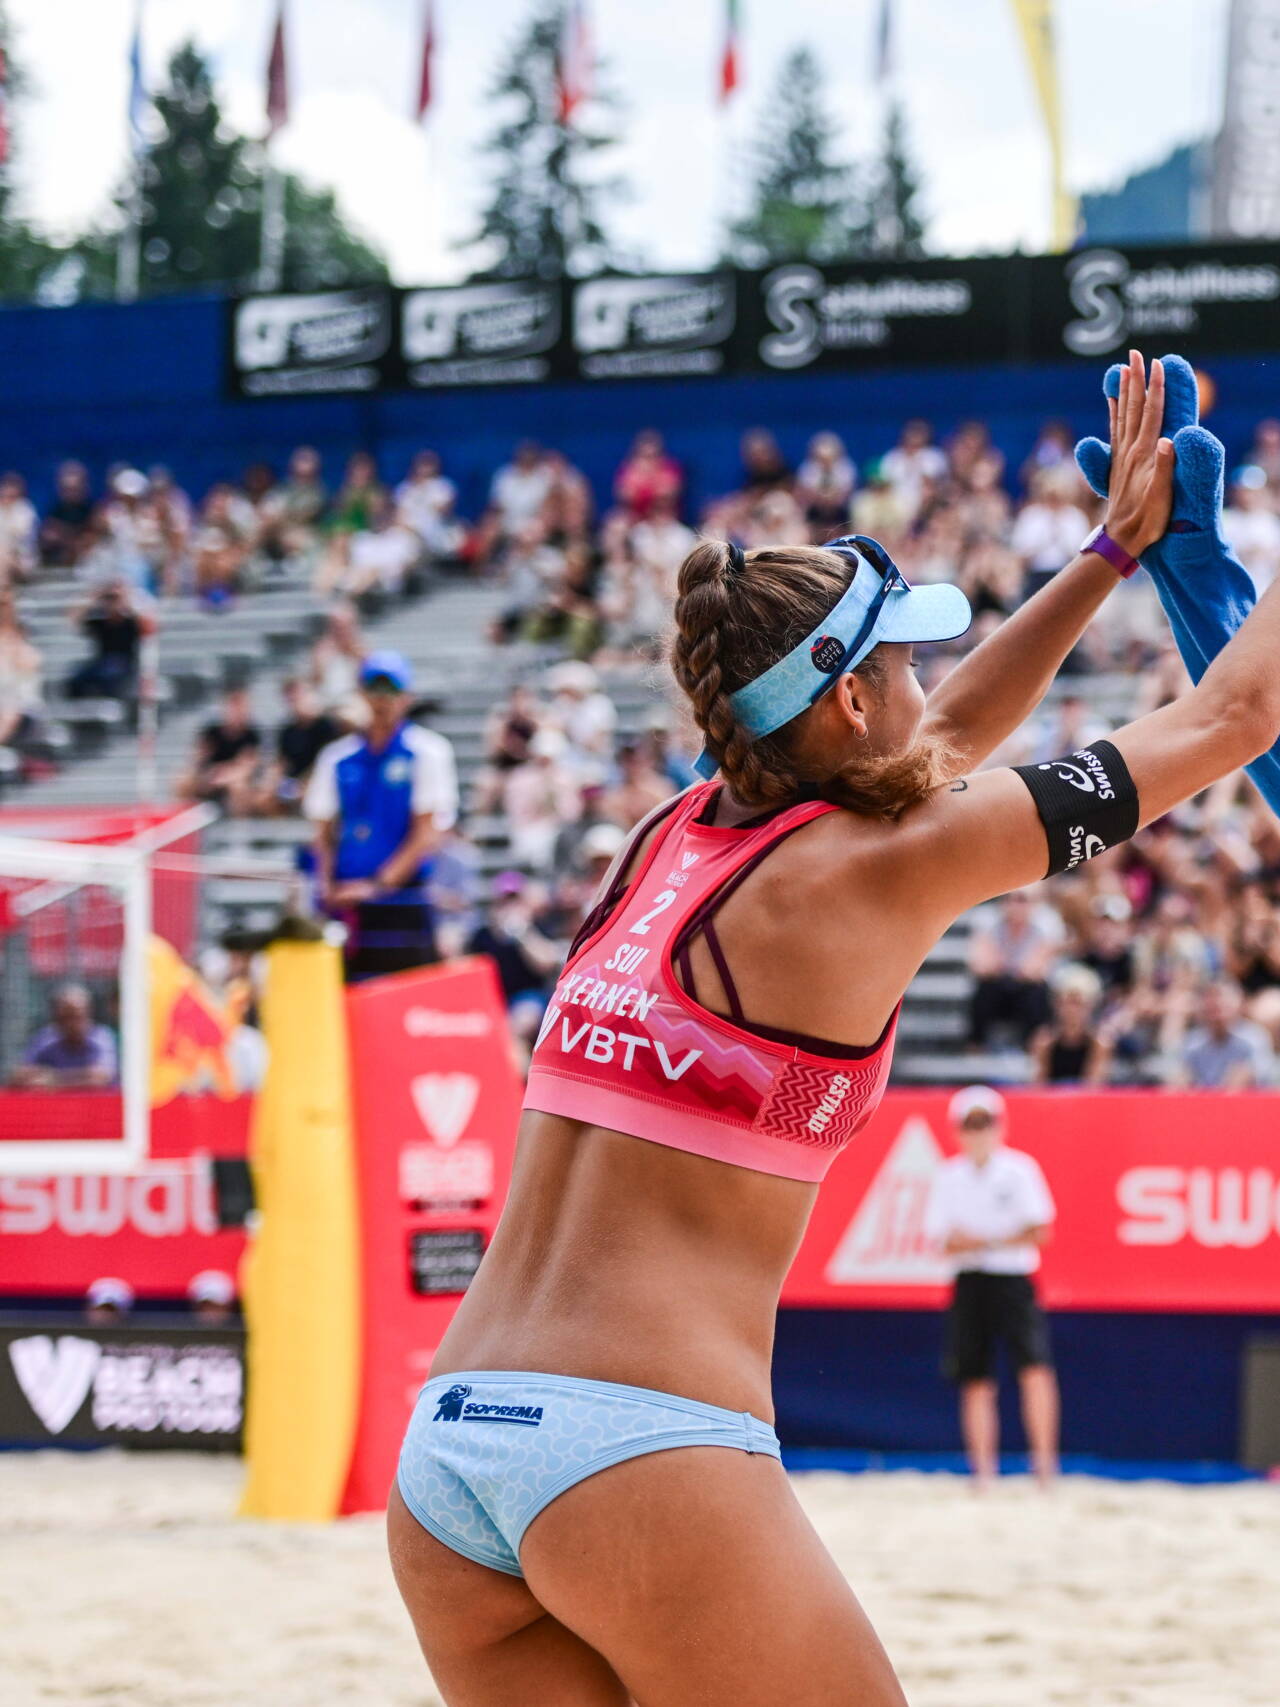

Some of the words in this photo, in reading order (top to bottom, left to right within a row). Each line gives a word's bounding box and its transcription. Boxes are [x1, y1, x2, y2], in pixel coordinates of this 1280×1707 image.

[820, 647, 843, 669] LATTE
[629, 889, 678, 935] 2
[604, 943, 650, 975] SUI
[559, 973, 660, 1022] KERNEN
[560, 1016, 704, 1081] VBTV
[808, 1074, 851, 1134] GSTAAD
[0, 1148, 218, 1237] swat
[463, 1402, 544, 1421] SOPREMA
